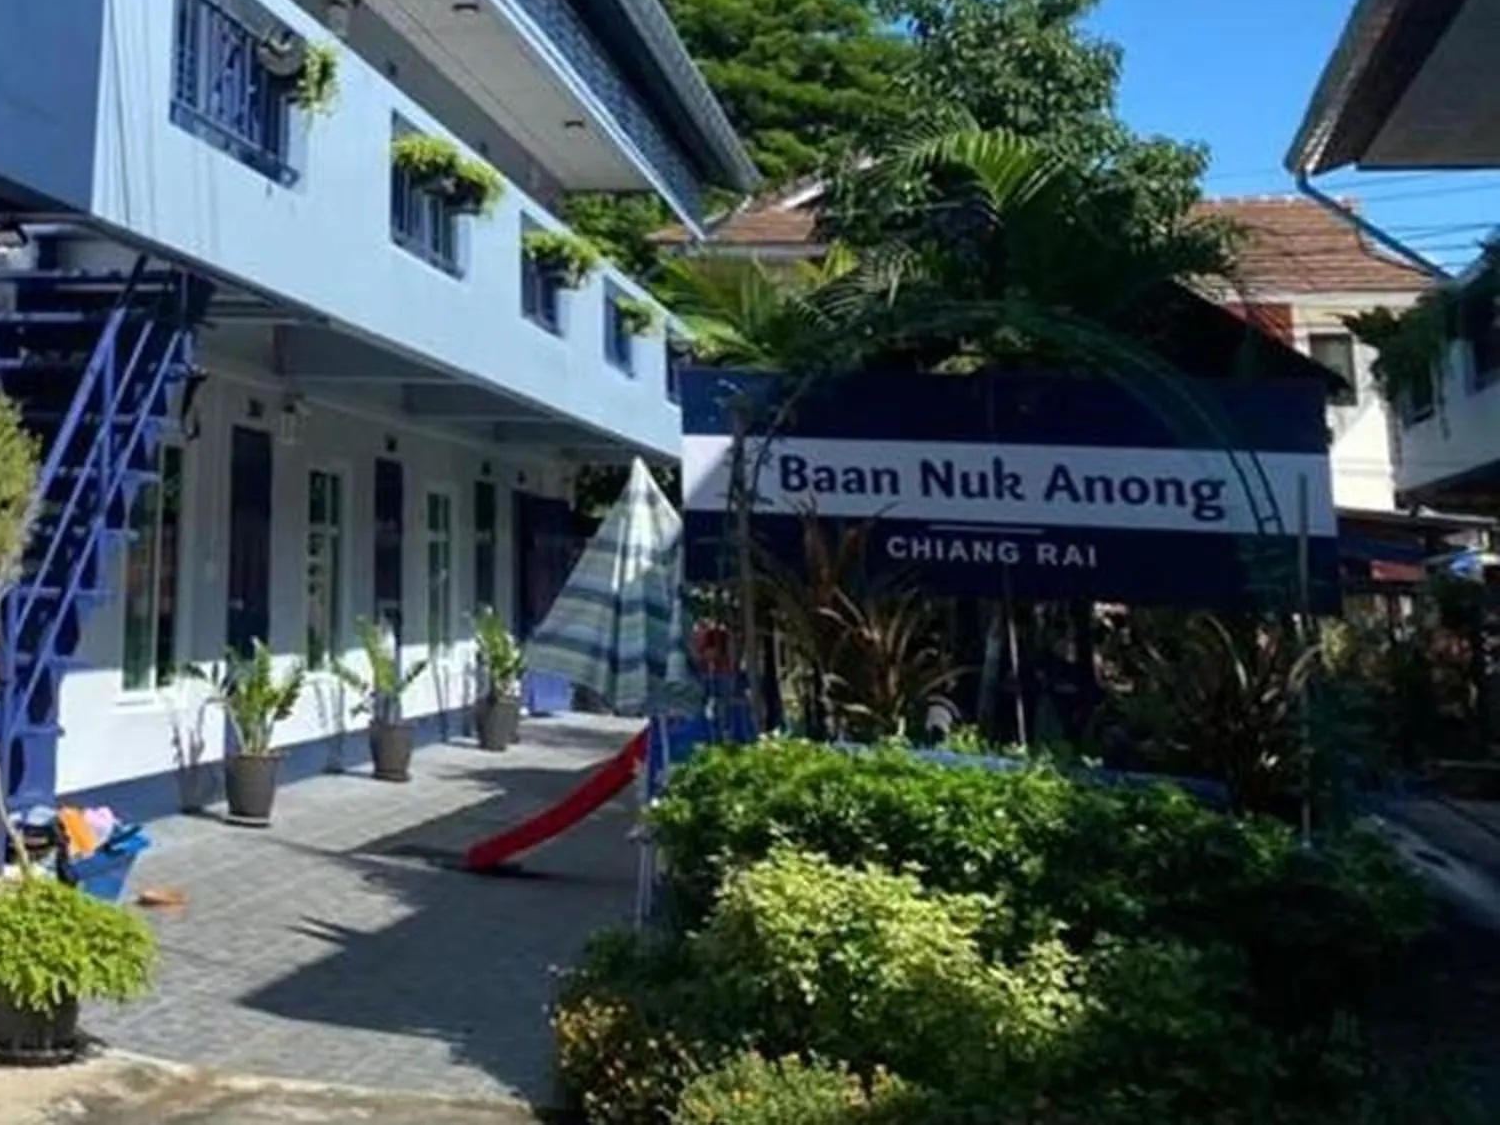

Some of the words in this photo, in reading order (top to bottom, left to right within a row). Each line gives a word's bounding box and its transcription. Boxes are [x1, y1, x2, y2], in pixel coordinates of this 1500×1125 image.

[779, 454, 900, 495] Baan
[918, 457, 1026, 502] Nuk
[1044, 463, 1227, 523] Anong
[886, 535, 1022, 565] CHIANG
[1036, 541, 1098, 569] RAI
